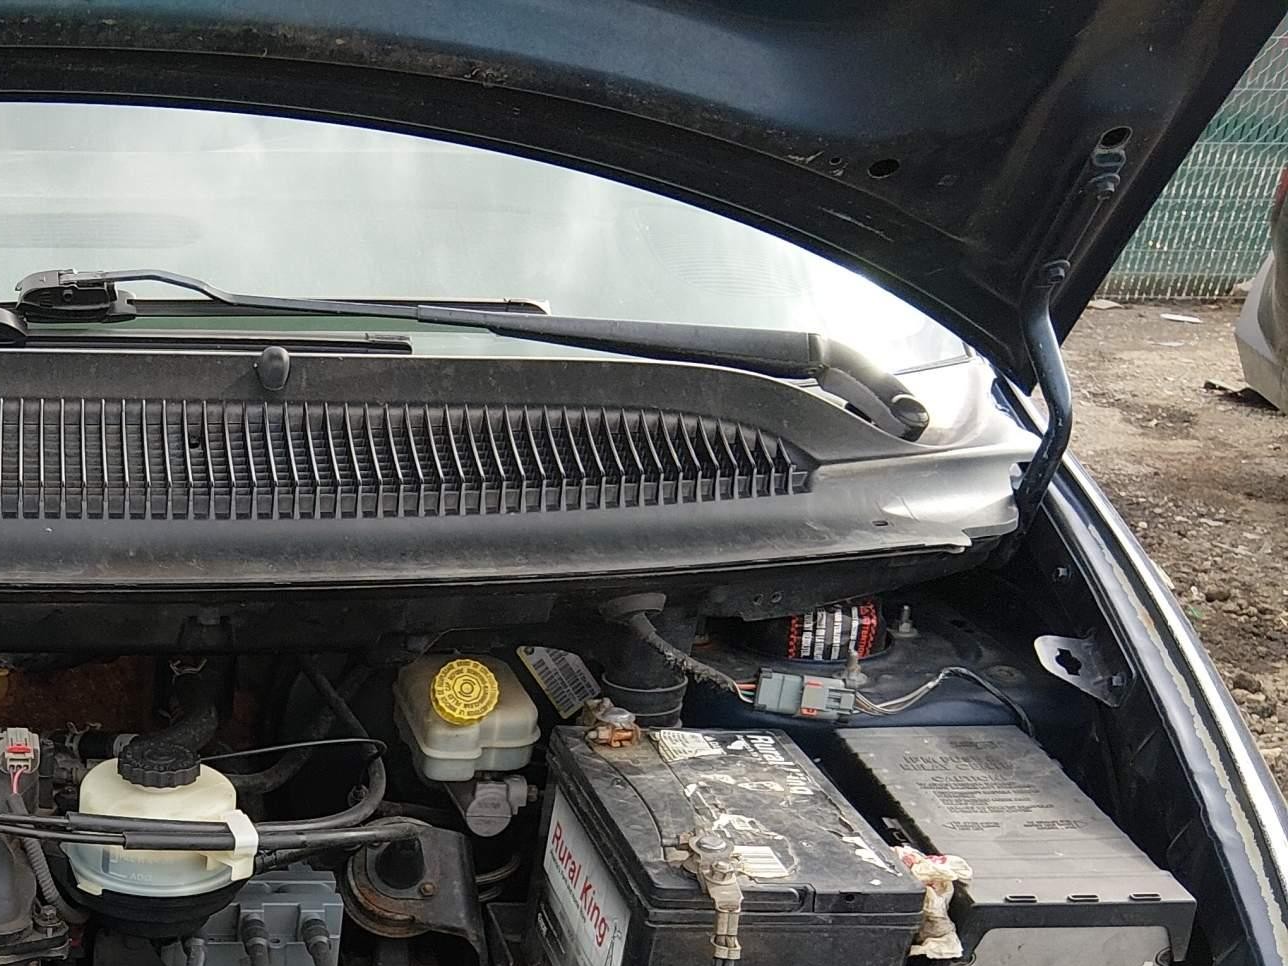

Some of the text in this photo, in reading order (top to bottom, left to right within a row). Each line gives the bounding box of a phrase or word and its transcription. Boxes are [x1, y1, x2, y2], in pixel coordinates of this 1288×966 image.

[748, 734, 795, 766] Rural
[551, 821, 582, 889] Rural
[579, 876, 609, 948] King
